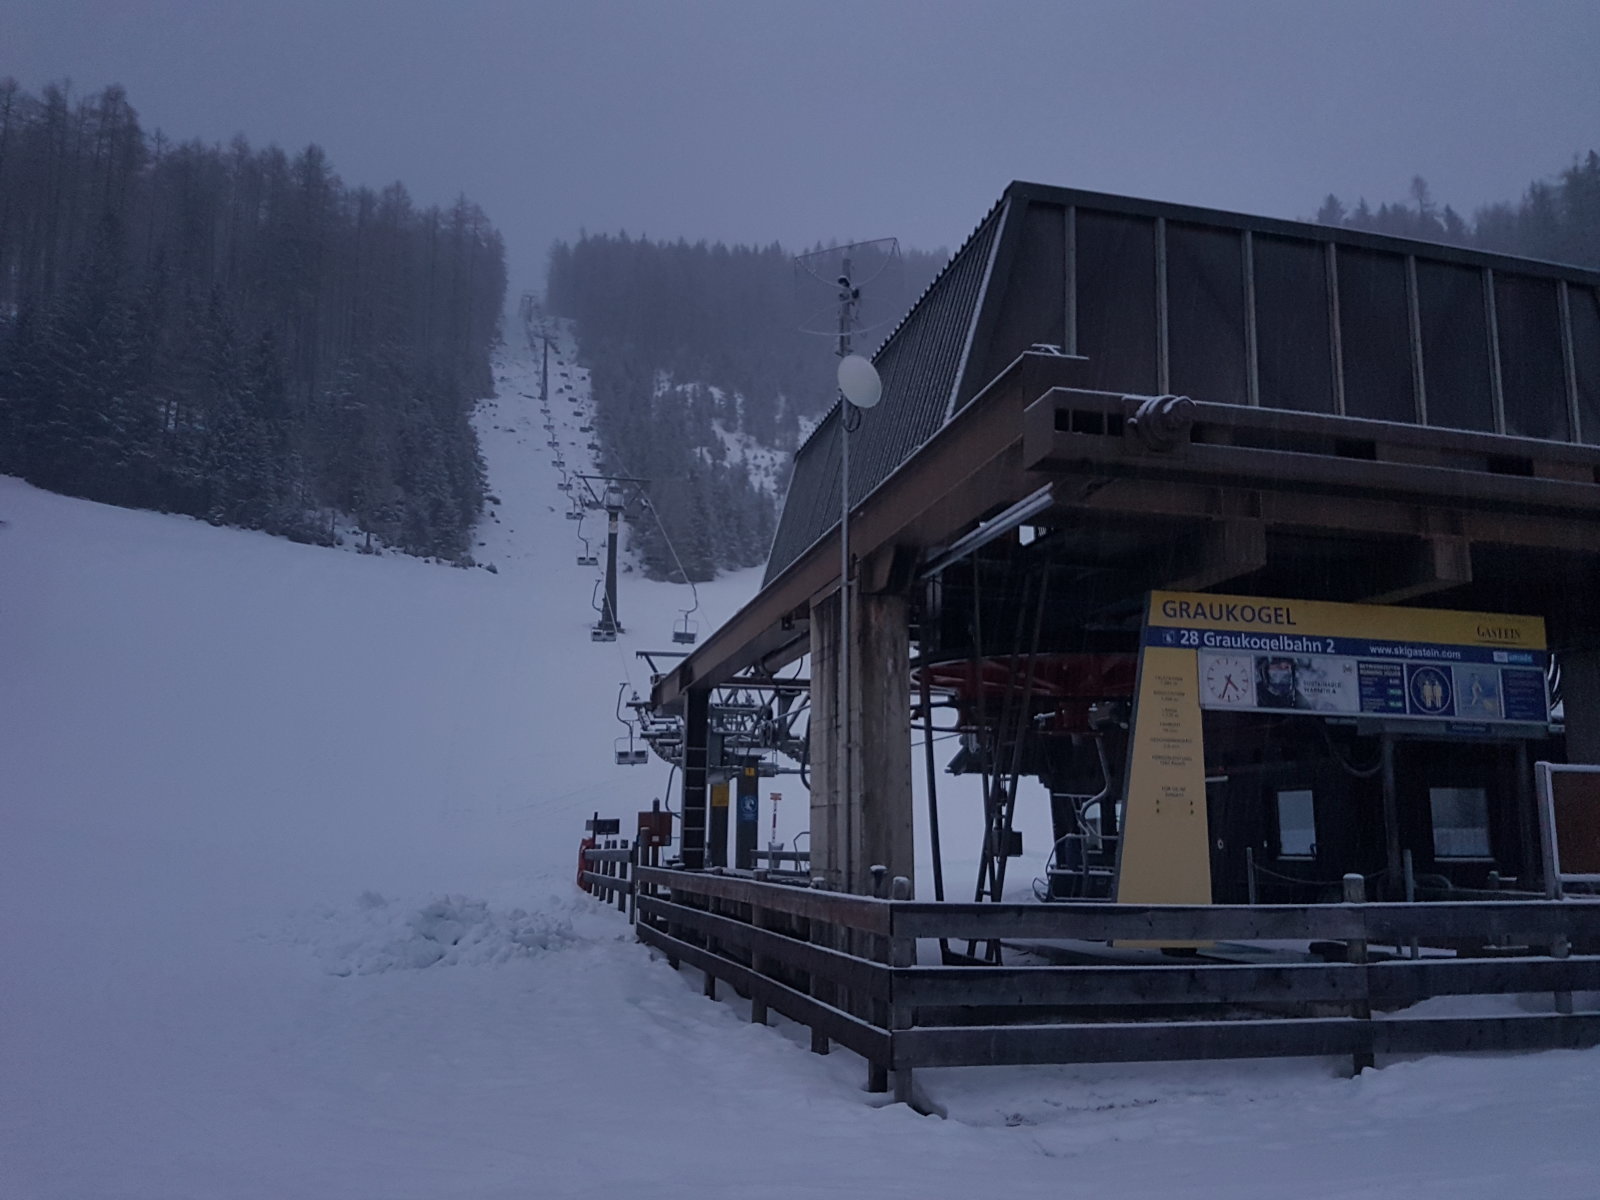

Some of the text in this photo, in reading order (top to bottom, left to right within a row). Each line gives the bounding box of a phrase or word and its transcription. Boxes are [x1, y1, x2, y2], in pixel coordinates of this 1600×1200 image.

[1162, 600, 1297, 625] GRAUKOGEL
[1180, 630, 1336, 654] 28 Graukogelbahn 2
[1369, 645, 1461, 659] www.skigastein.com
